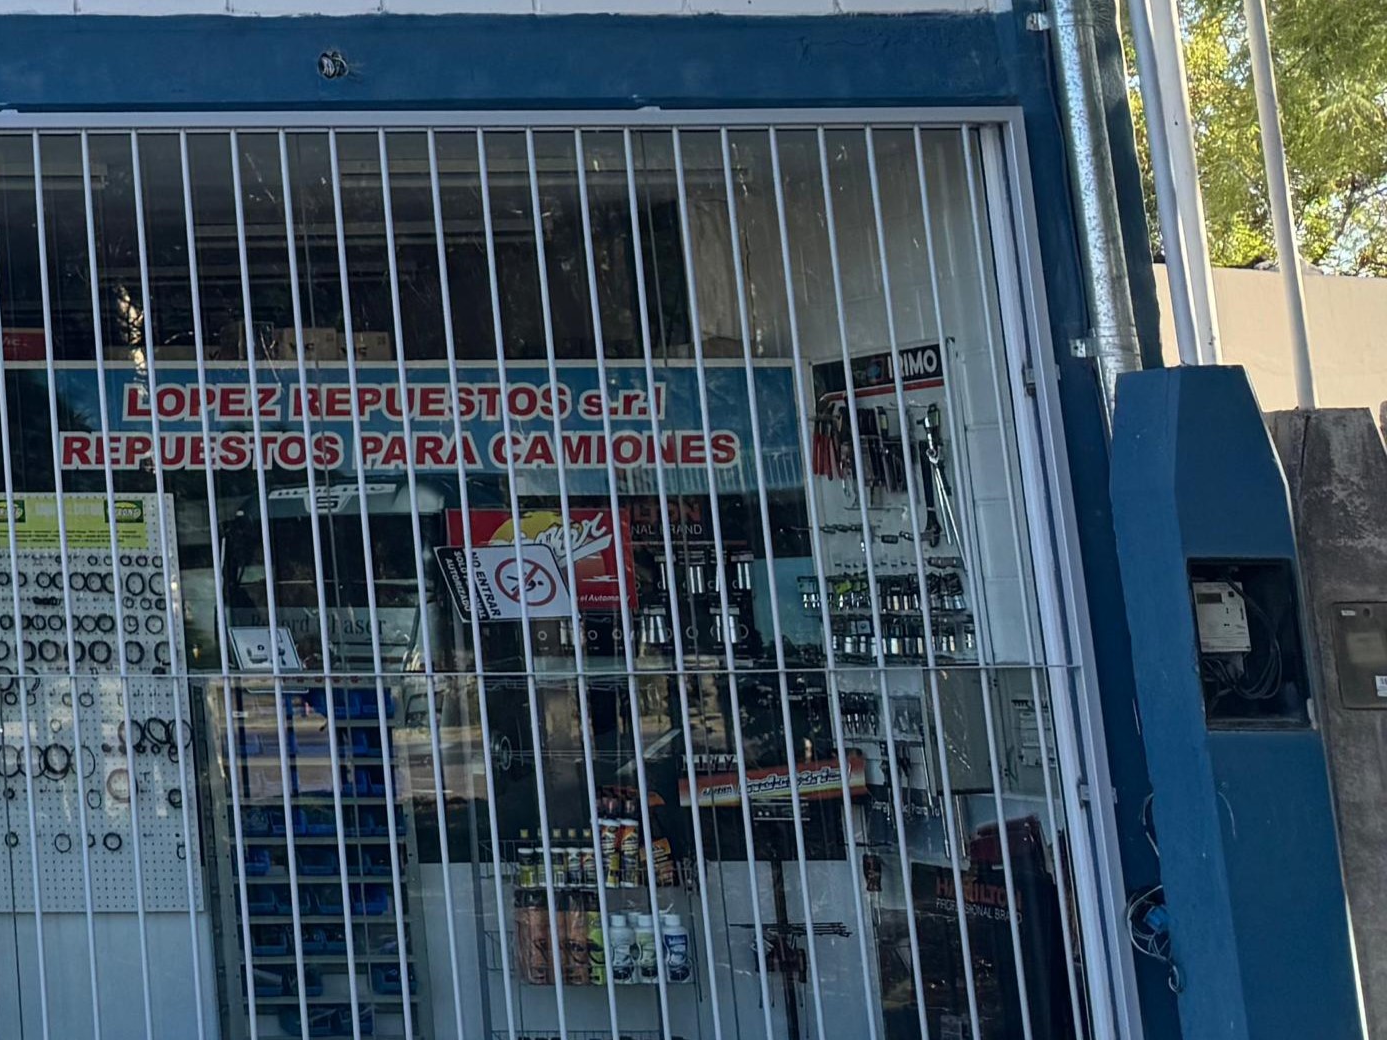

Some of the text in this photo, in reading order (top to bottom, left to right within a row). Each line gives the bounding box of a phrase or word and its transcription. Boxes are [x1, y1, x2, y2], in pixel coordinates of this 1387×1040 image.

[124, 383, 280, 420] LOPEZ
[289, 383, 571, 421] REPUESTOS
[60, 430, 739, 470] REPUESTOS PARA CAMIONES
[659, 523, 703, 535] RAND
[476, 571, 502, 616] ENTRAR
[317, 612, 388, 636] haser
[935, 896, 1023, 925] PROFSIONAL BRAD
